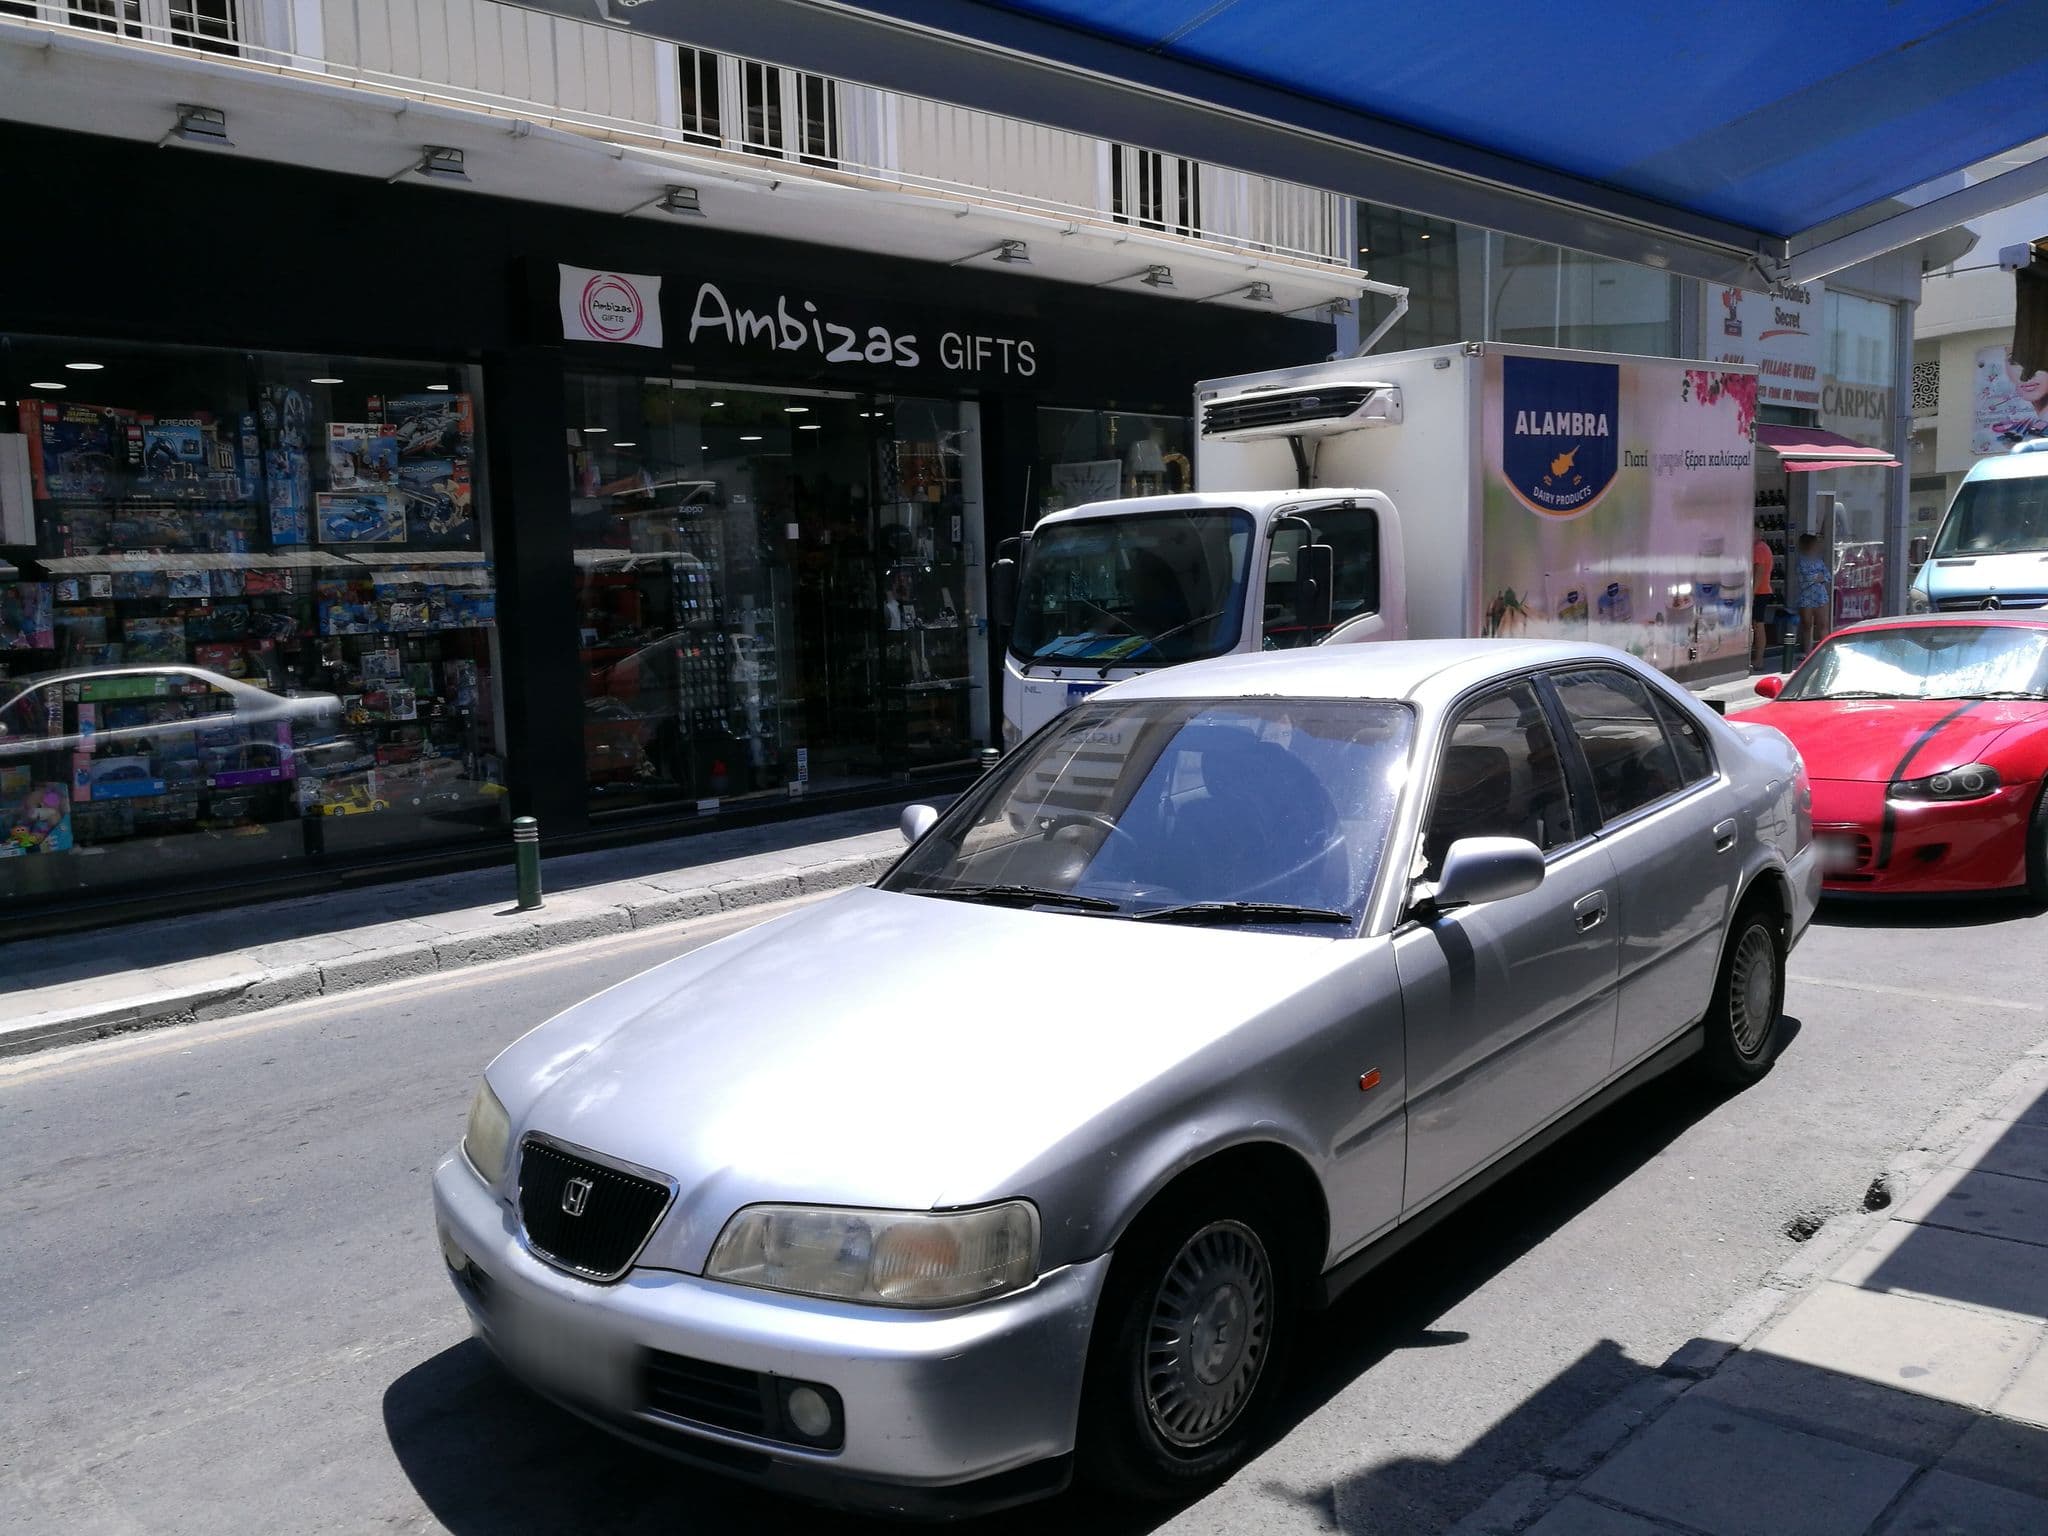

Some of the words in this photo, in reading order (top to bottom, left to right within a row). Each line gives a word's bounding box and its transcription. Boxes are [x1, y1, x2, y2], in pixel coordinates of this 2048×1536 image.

[593, 300, 632, 313] Ambizas
[1775, 306, 1800, 328] Secret
[601, 314, 625, 323] GIFTS
[689, 282, 920, 368] Ambizas
[940, 332, 1037, 376] GIFTS
[1823, 384, 1886, 420] CARPISA
[159, 418, 202, 427] CREATOR
[1515, 410, 1609, 437] ALAMBRA
[1624, 450, 1649, 467] Γιατί
[1685, 450, 1707, 471] ξέρει
[1708, 450, 1751, 471] καλύτερα!
[1533, 486, 1554, 504] DAIRY
[1556, 485, 1592, 505] PRODUCTS
